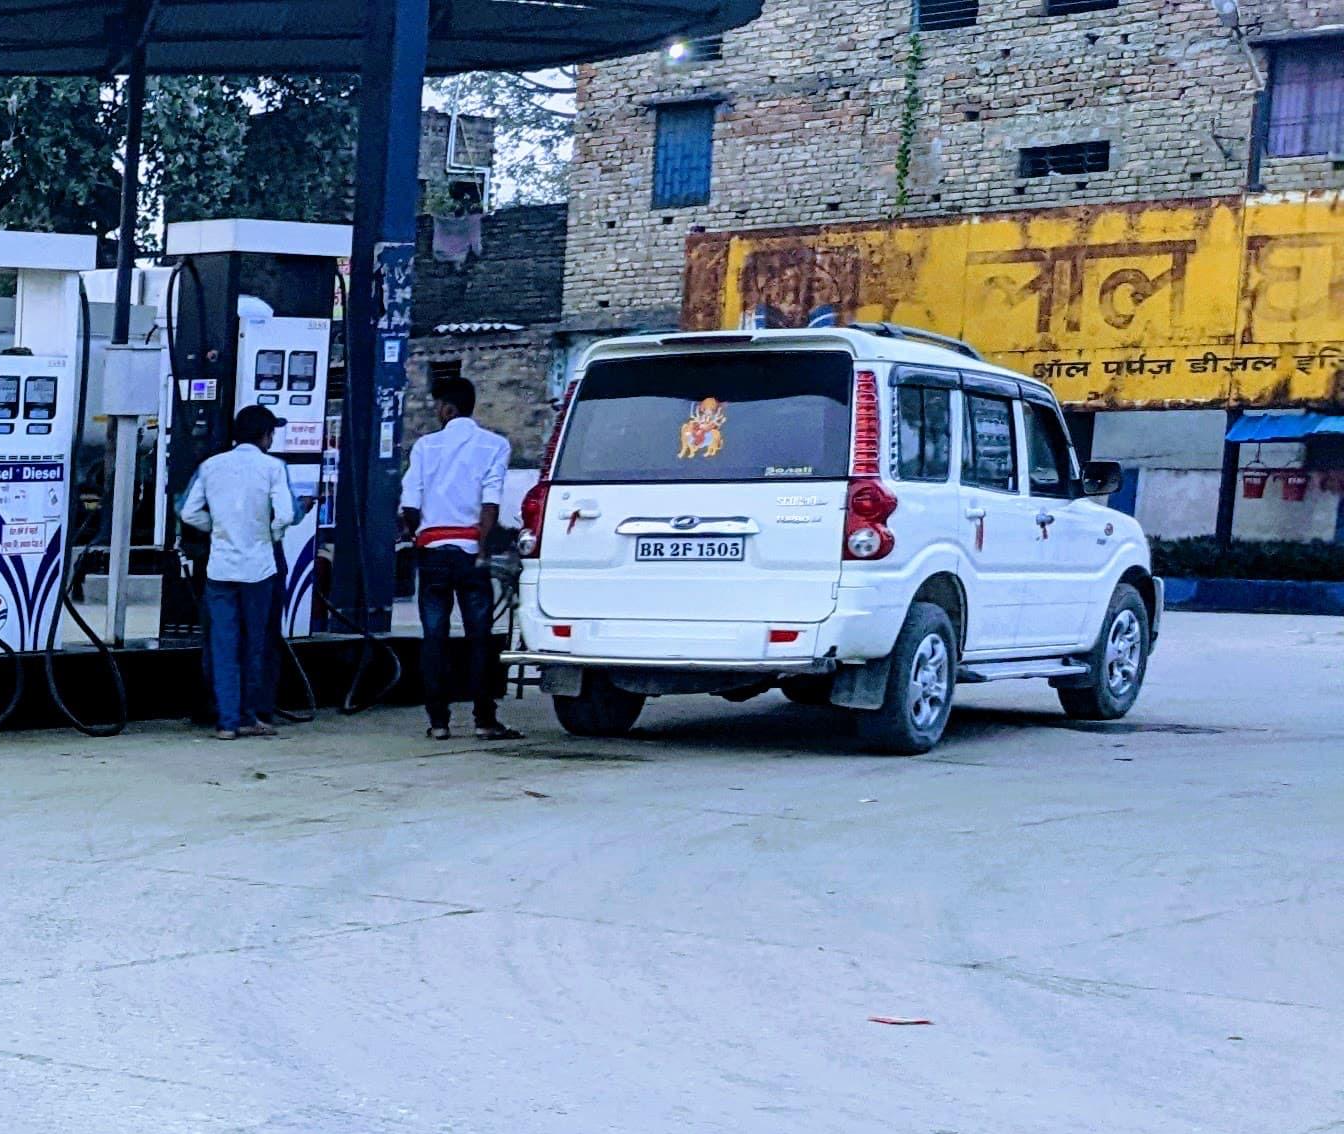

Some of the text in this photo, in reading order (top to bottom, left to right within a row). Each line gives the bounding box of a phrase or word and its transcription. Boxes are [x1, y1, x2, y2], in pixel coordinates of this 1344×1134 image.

[966, 239, 1197, 333] लाल
[1032, 358, 1092, 379] ऑल
[22, 466, 61, 480] Diesel
[639, 542, 740, 557] BR 2F 1505
